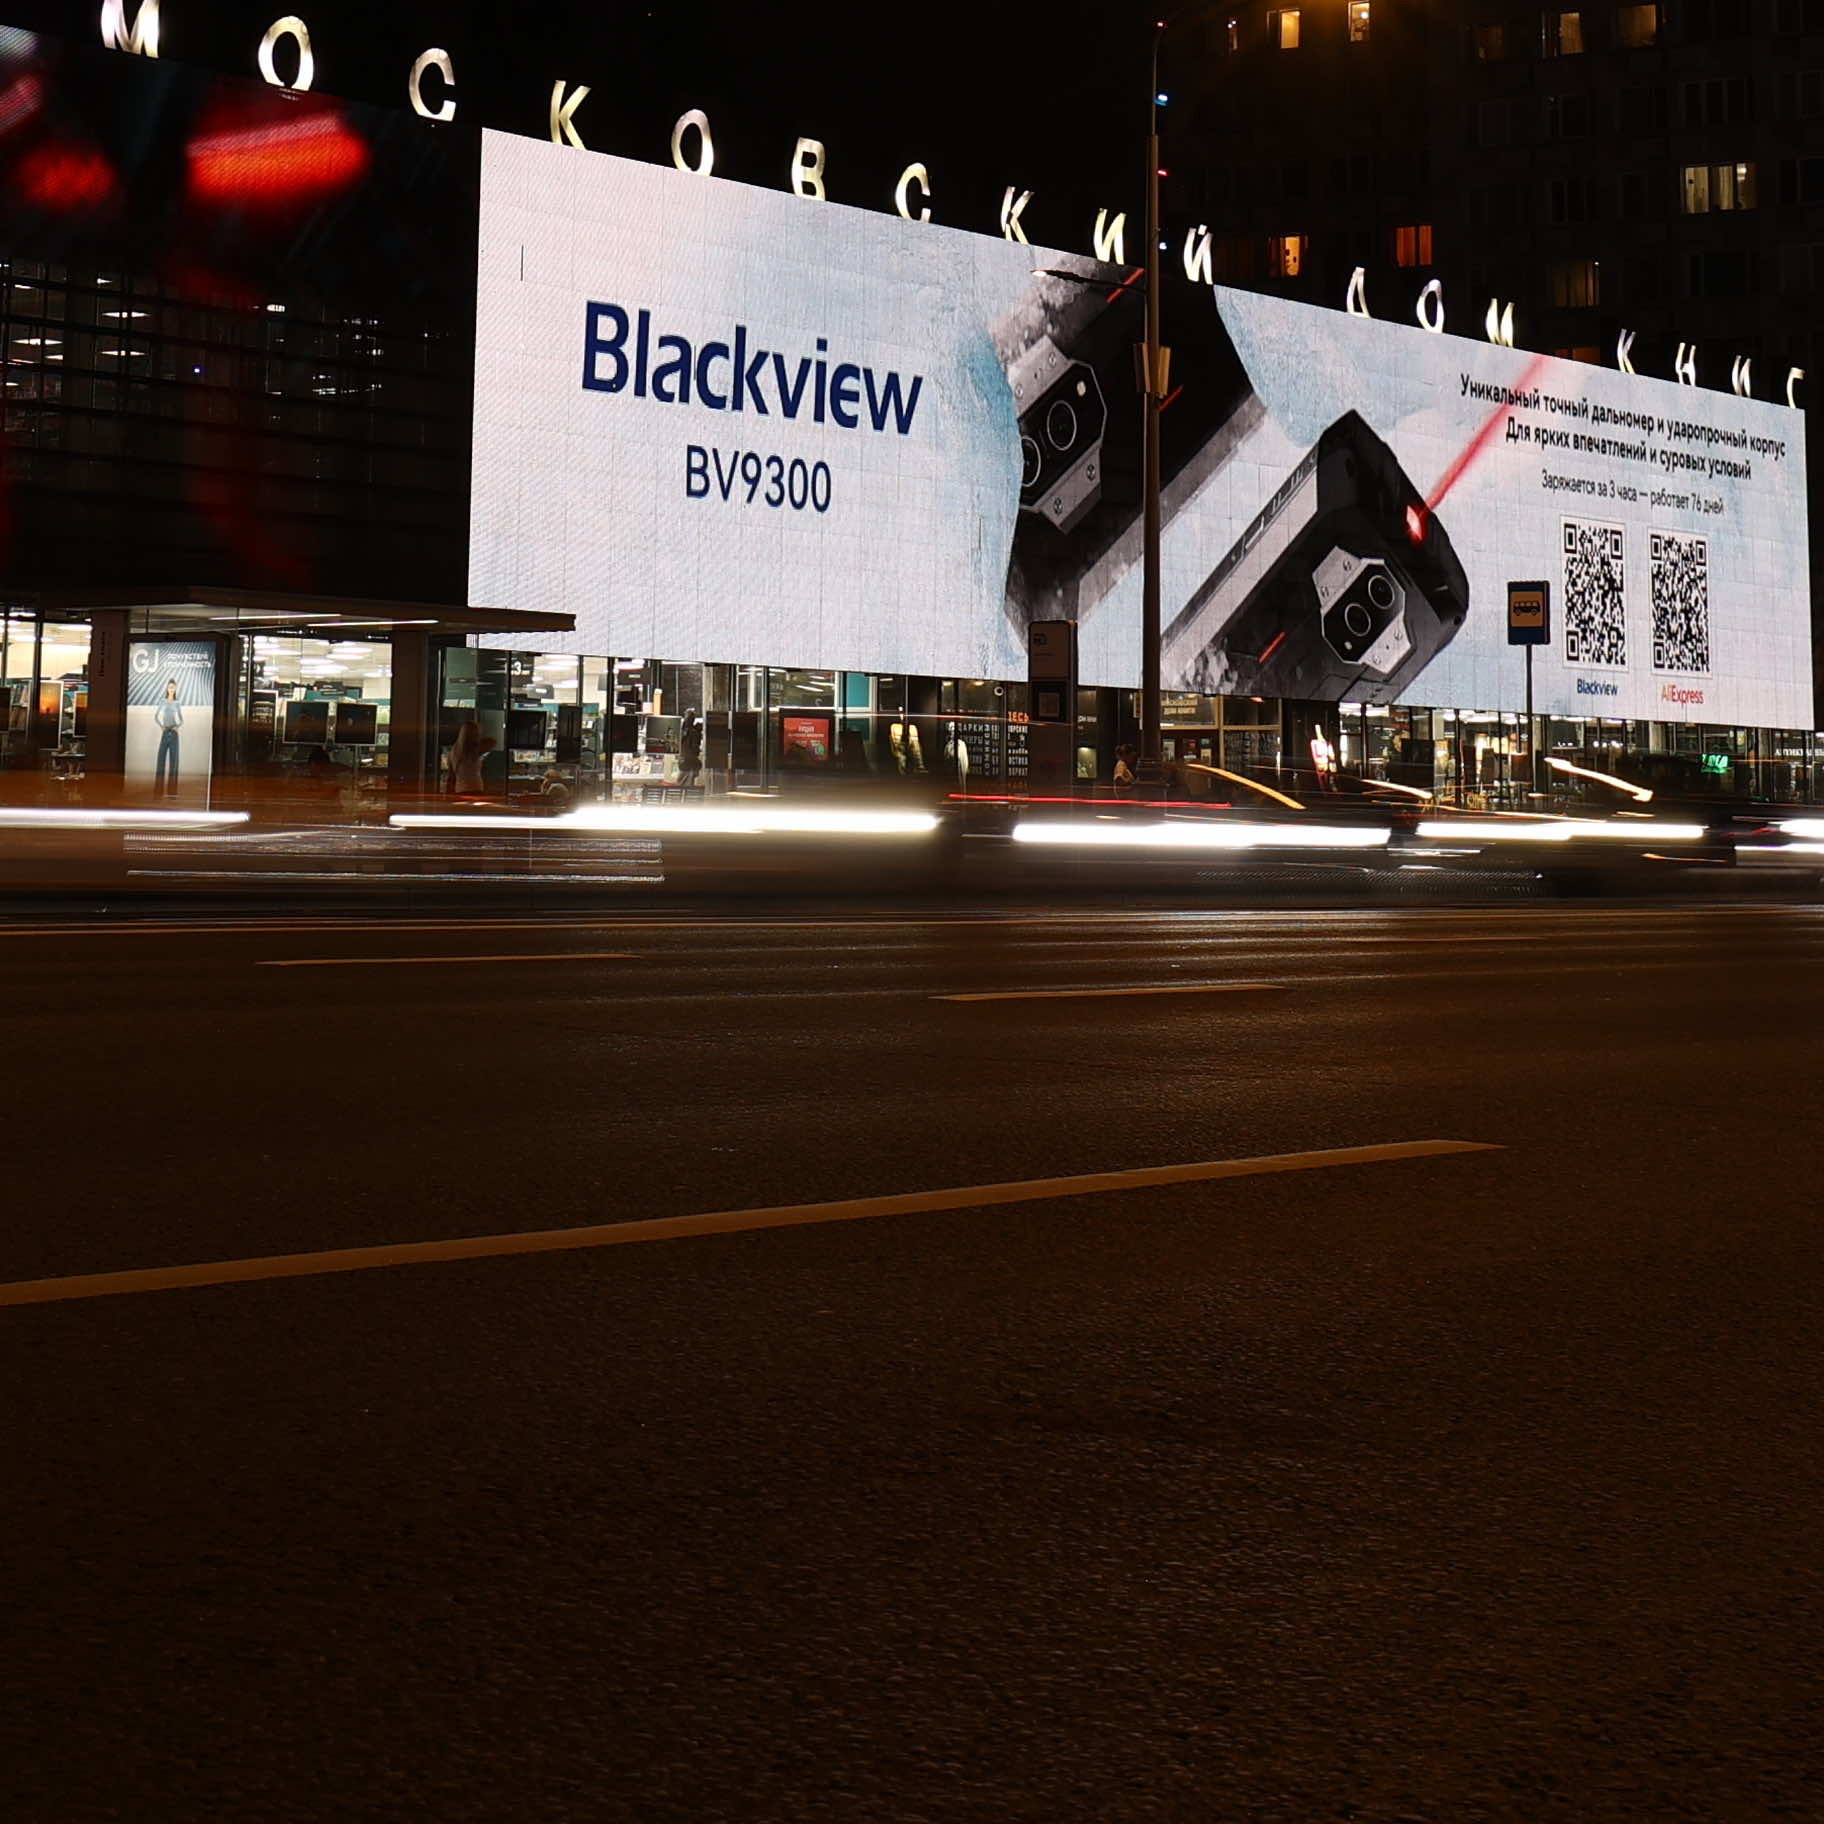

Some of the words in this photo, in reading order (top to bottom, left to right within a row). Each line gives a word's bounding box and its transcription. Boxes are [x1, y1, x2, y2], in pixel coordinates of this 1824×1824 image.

[1346, 266, 1514, 348] ДОМ
[582, 300, 923, 435] Blackview
[1461, 373, 1540, 410] Уникальный
[1543, 395, 1588, 419] точный
[1591, 405, 1654, 436] дальномер
[1657, 417, 1664, 433] и
[1667, 419, 1747, 449] ударопрочный
[1750, 436, 1786, 460] корпус
[1506, 416, 1531, 442] Для
[1534, 427, 1570, 451] ярких
[1573, 434, 1646, 462] впечатлений
[1649, 448, 1657, 461] и
[1660, 449, 1706, 472] суровых
[1708, 458, 1752, 480] условий
[686, 444, 832, 514] BV9300
[1541, 469, 1596, 495] Заряжается
[1597, 482, 1608, 495] за
[1609, 480, 1616, 499] 3
[1617, 486, 1638, 502] часа
[1650, 488, 1689, 509] работает
[1691, 492, 1702, 513] 76
[1703, 497, 1725, 515] дней
[133, 648, 160, 673] GJ
[1577, 678, 1618, 696] Blackview
